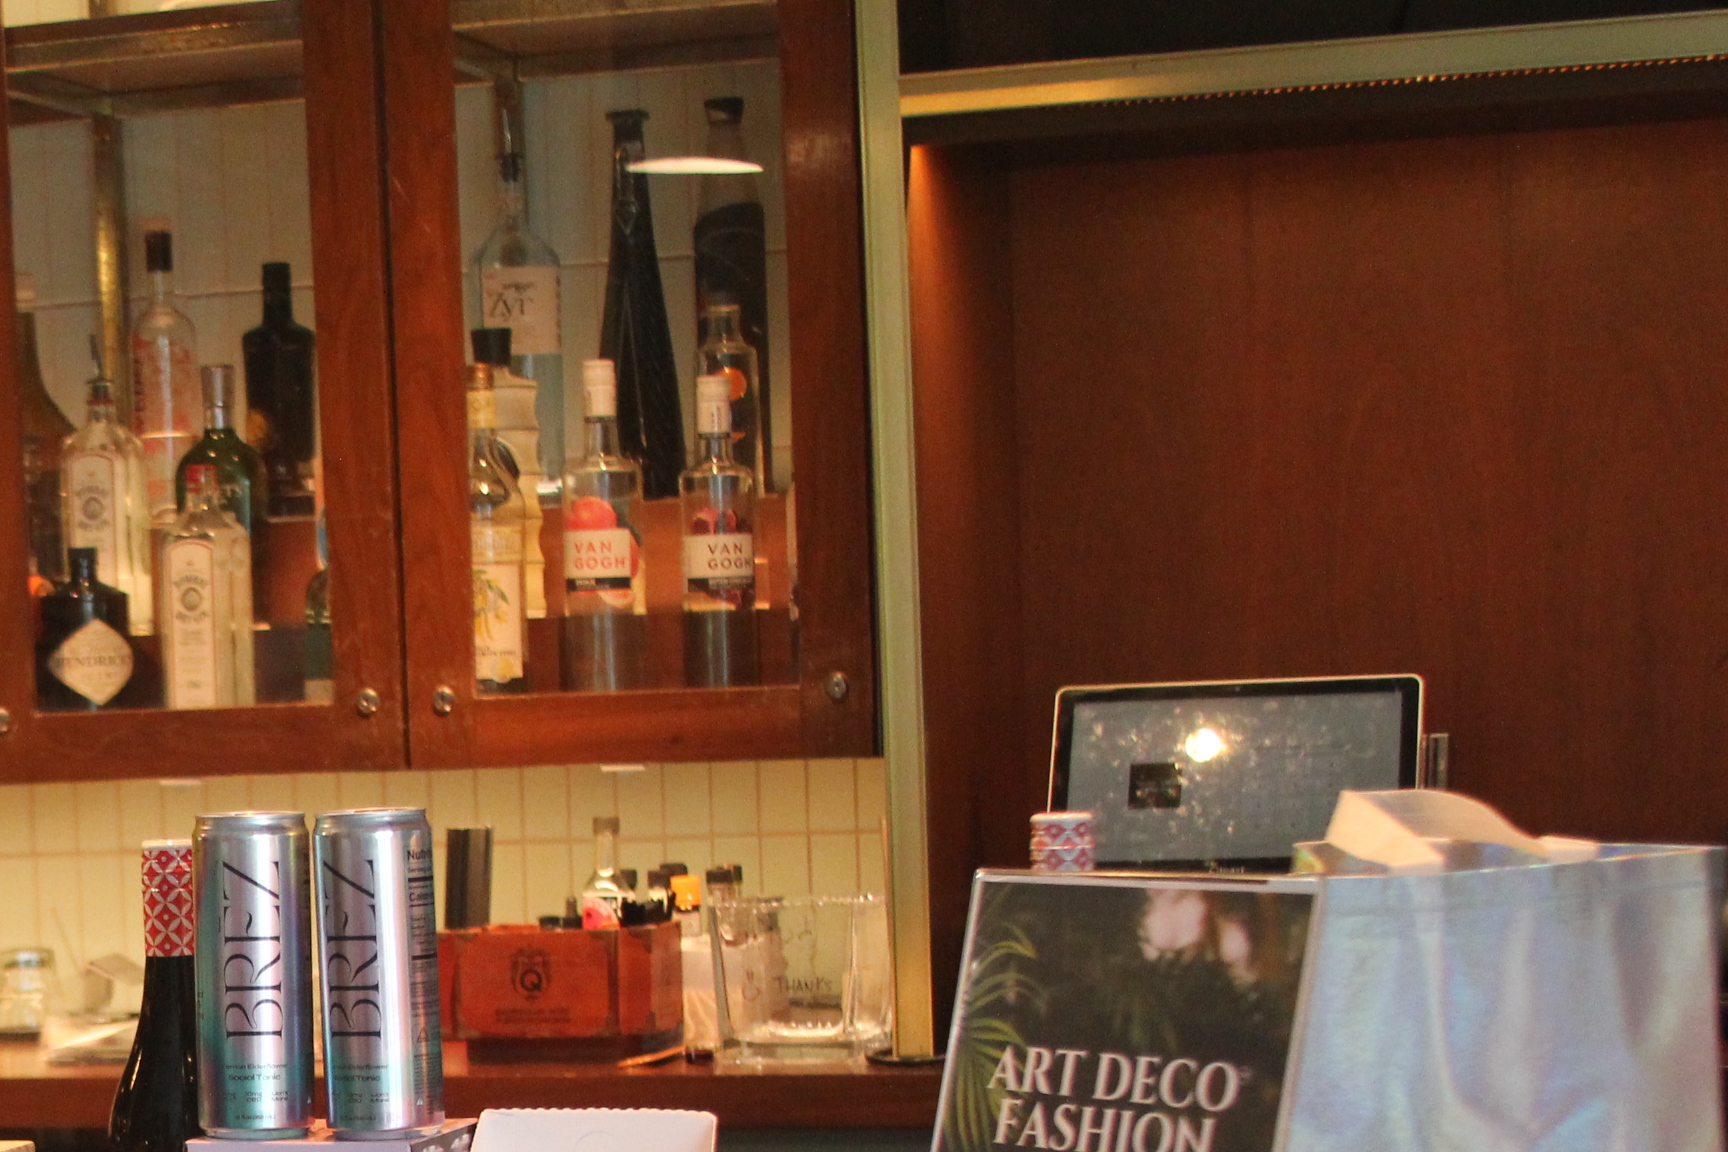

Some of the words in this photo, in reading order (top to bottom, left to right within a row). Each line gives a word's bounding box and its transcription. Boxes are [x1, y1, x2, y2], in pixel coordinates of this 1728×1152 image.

[574, 541, 612, 555] VAN
[707, 542, 743, 555] VAN
[574, 556, 627, 571] GOGH
[228, 1073, 255, 1081] Social
[256, 1073, 281, 1081] Tonic
[986, 1045, 1088, 1097] ART
[1092, 1052, 1242, 1113] DECO
